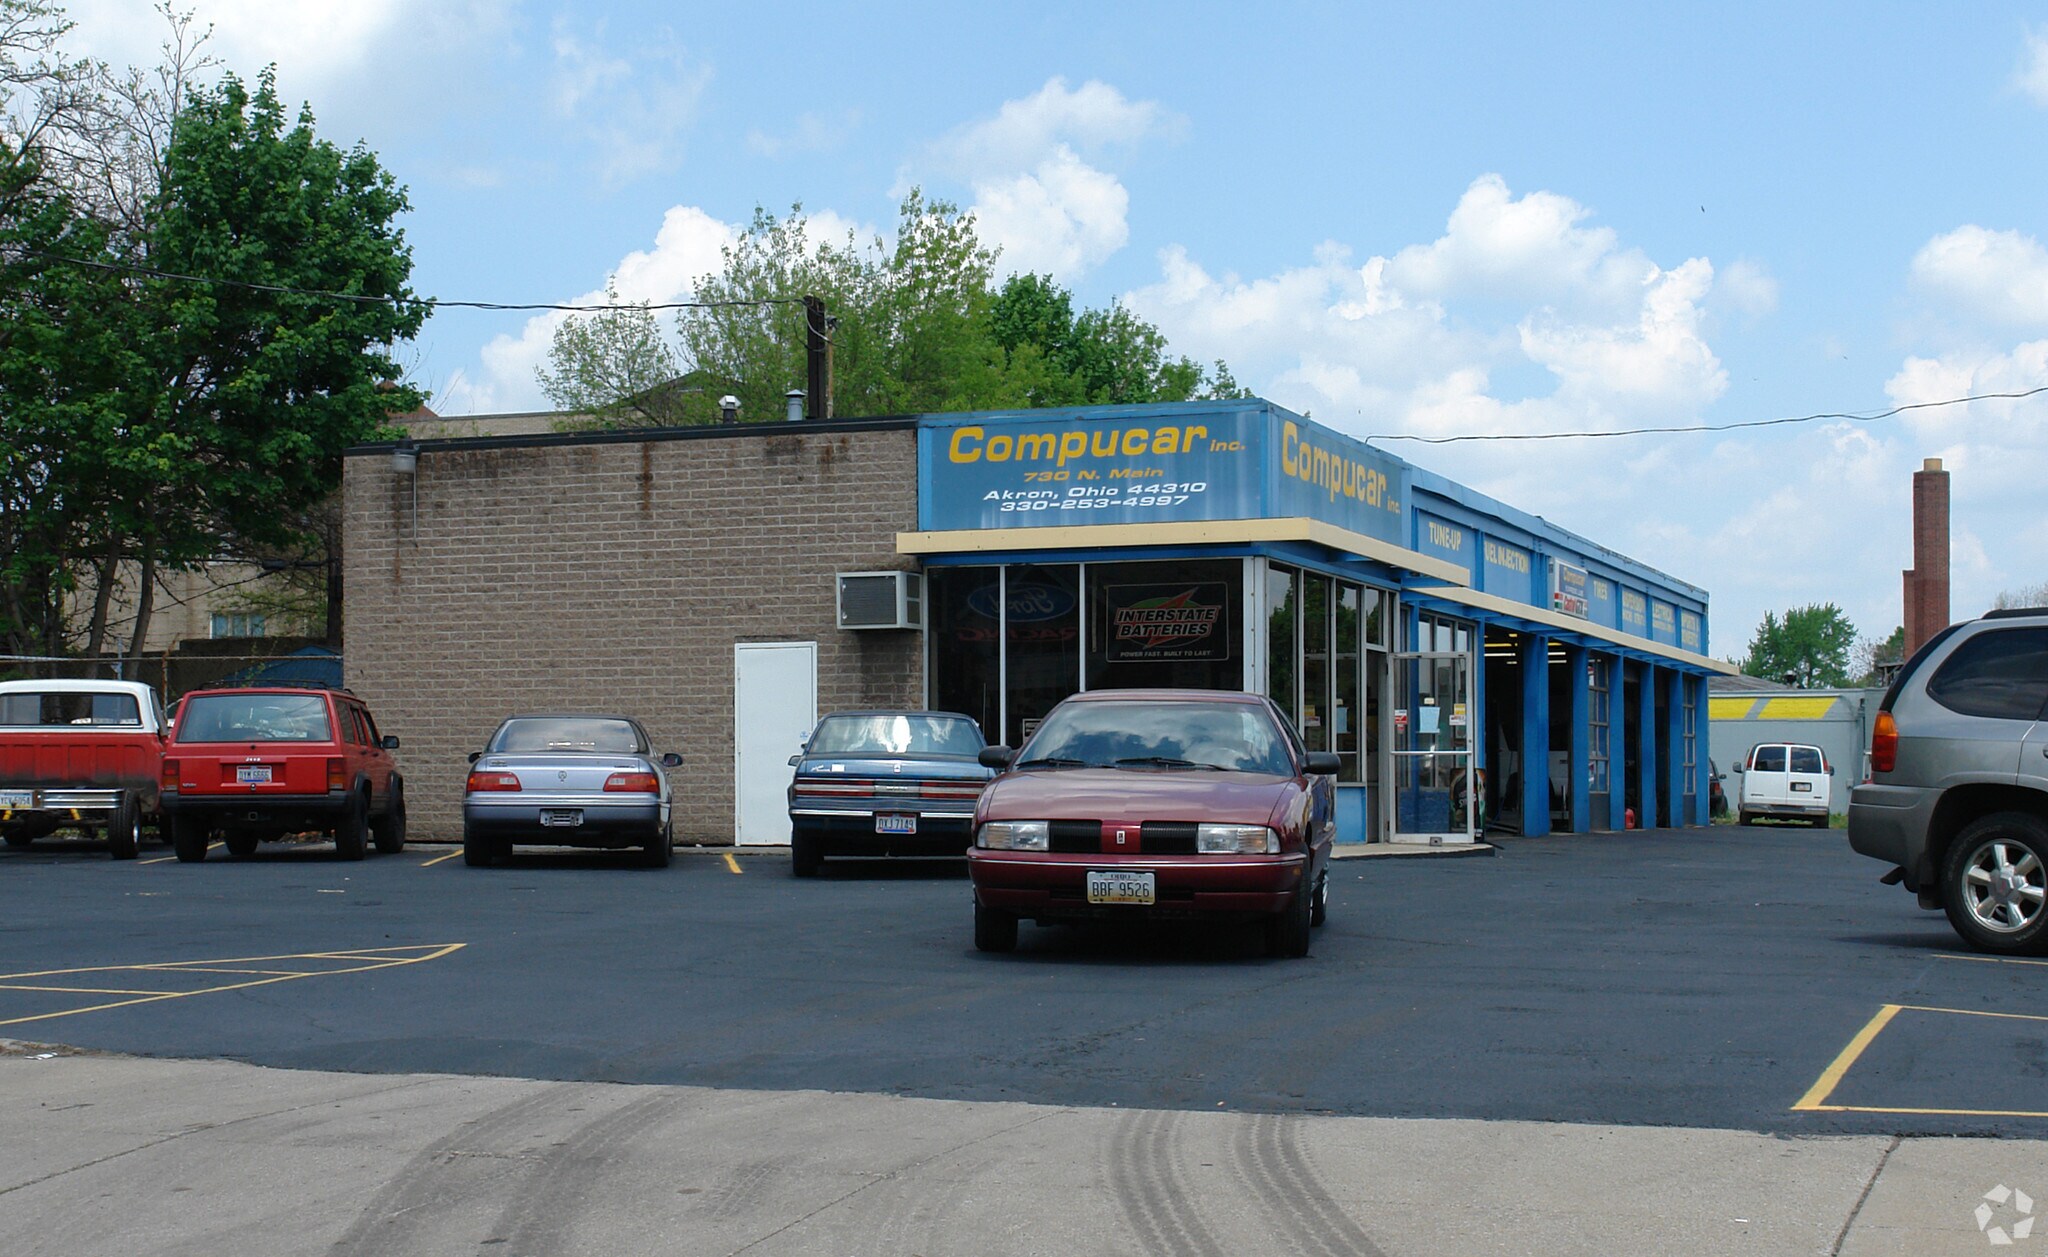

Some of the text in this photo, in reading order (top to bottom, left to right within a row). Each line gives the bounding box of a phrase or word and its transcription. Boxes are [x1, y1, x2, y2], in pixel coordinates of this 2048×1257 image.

[949, 425, 1246, 467] Compucar inc.
[1024, 467, 1164, 482] 730 N. Main
[1282, 421, 1401, 514] Compucar inc.
[983, 482, 1207, 501] Akron, Ohio 44310
[1000, 495, 1189, 512] 330-253-4997
[1428, 521, 1462, 552] TUNE-UP
[1484, 540, 1530, 574] UEL INJECTION
[1593, 580, 1608, 601] TIRES
[1117, 608, 1217, 622] INTERSTATE
[1119, 623, 1209, 637] BATTERIES
[895, 818, 914, 829] 7149
[1092, 881, 1150, 898] BBF 9526
